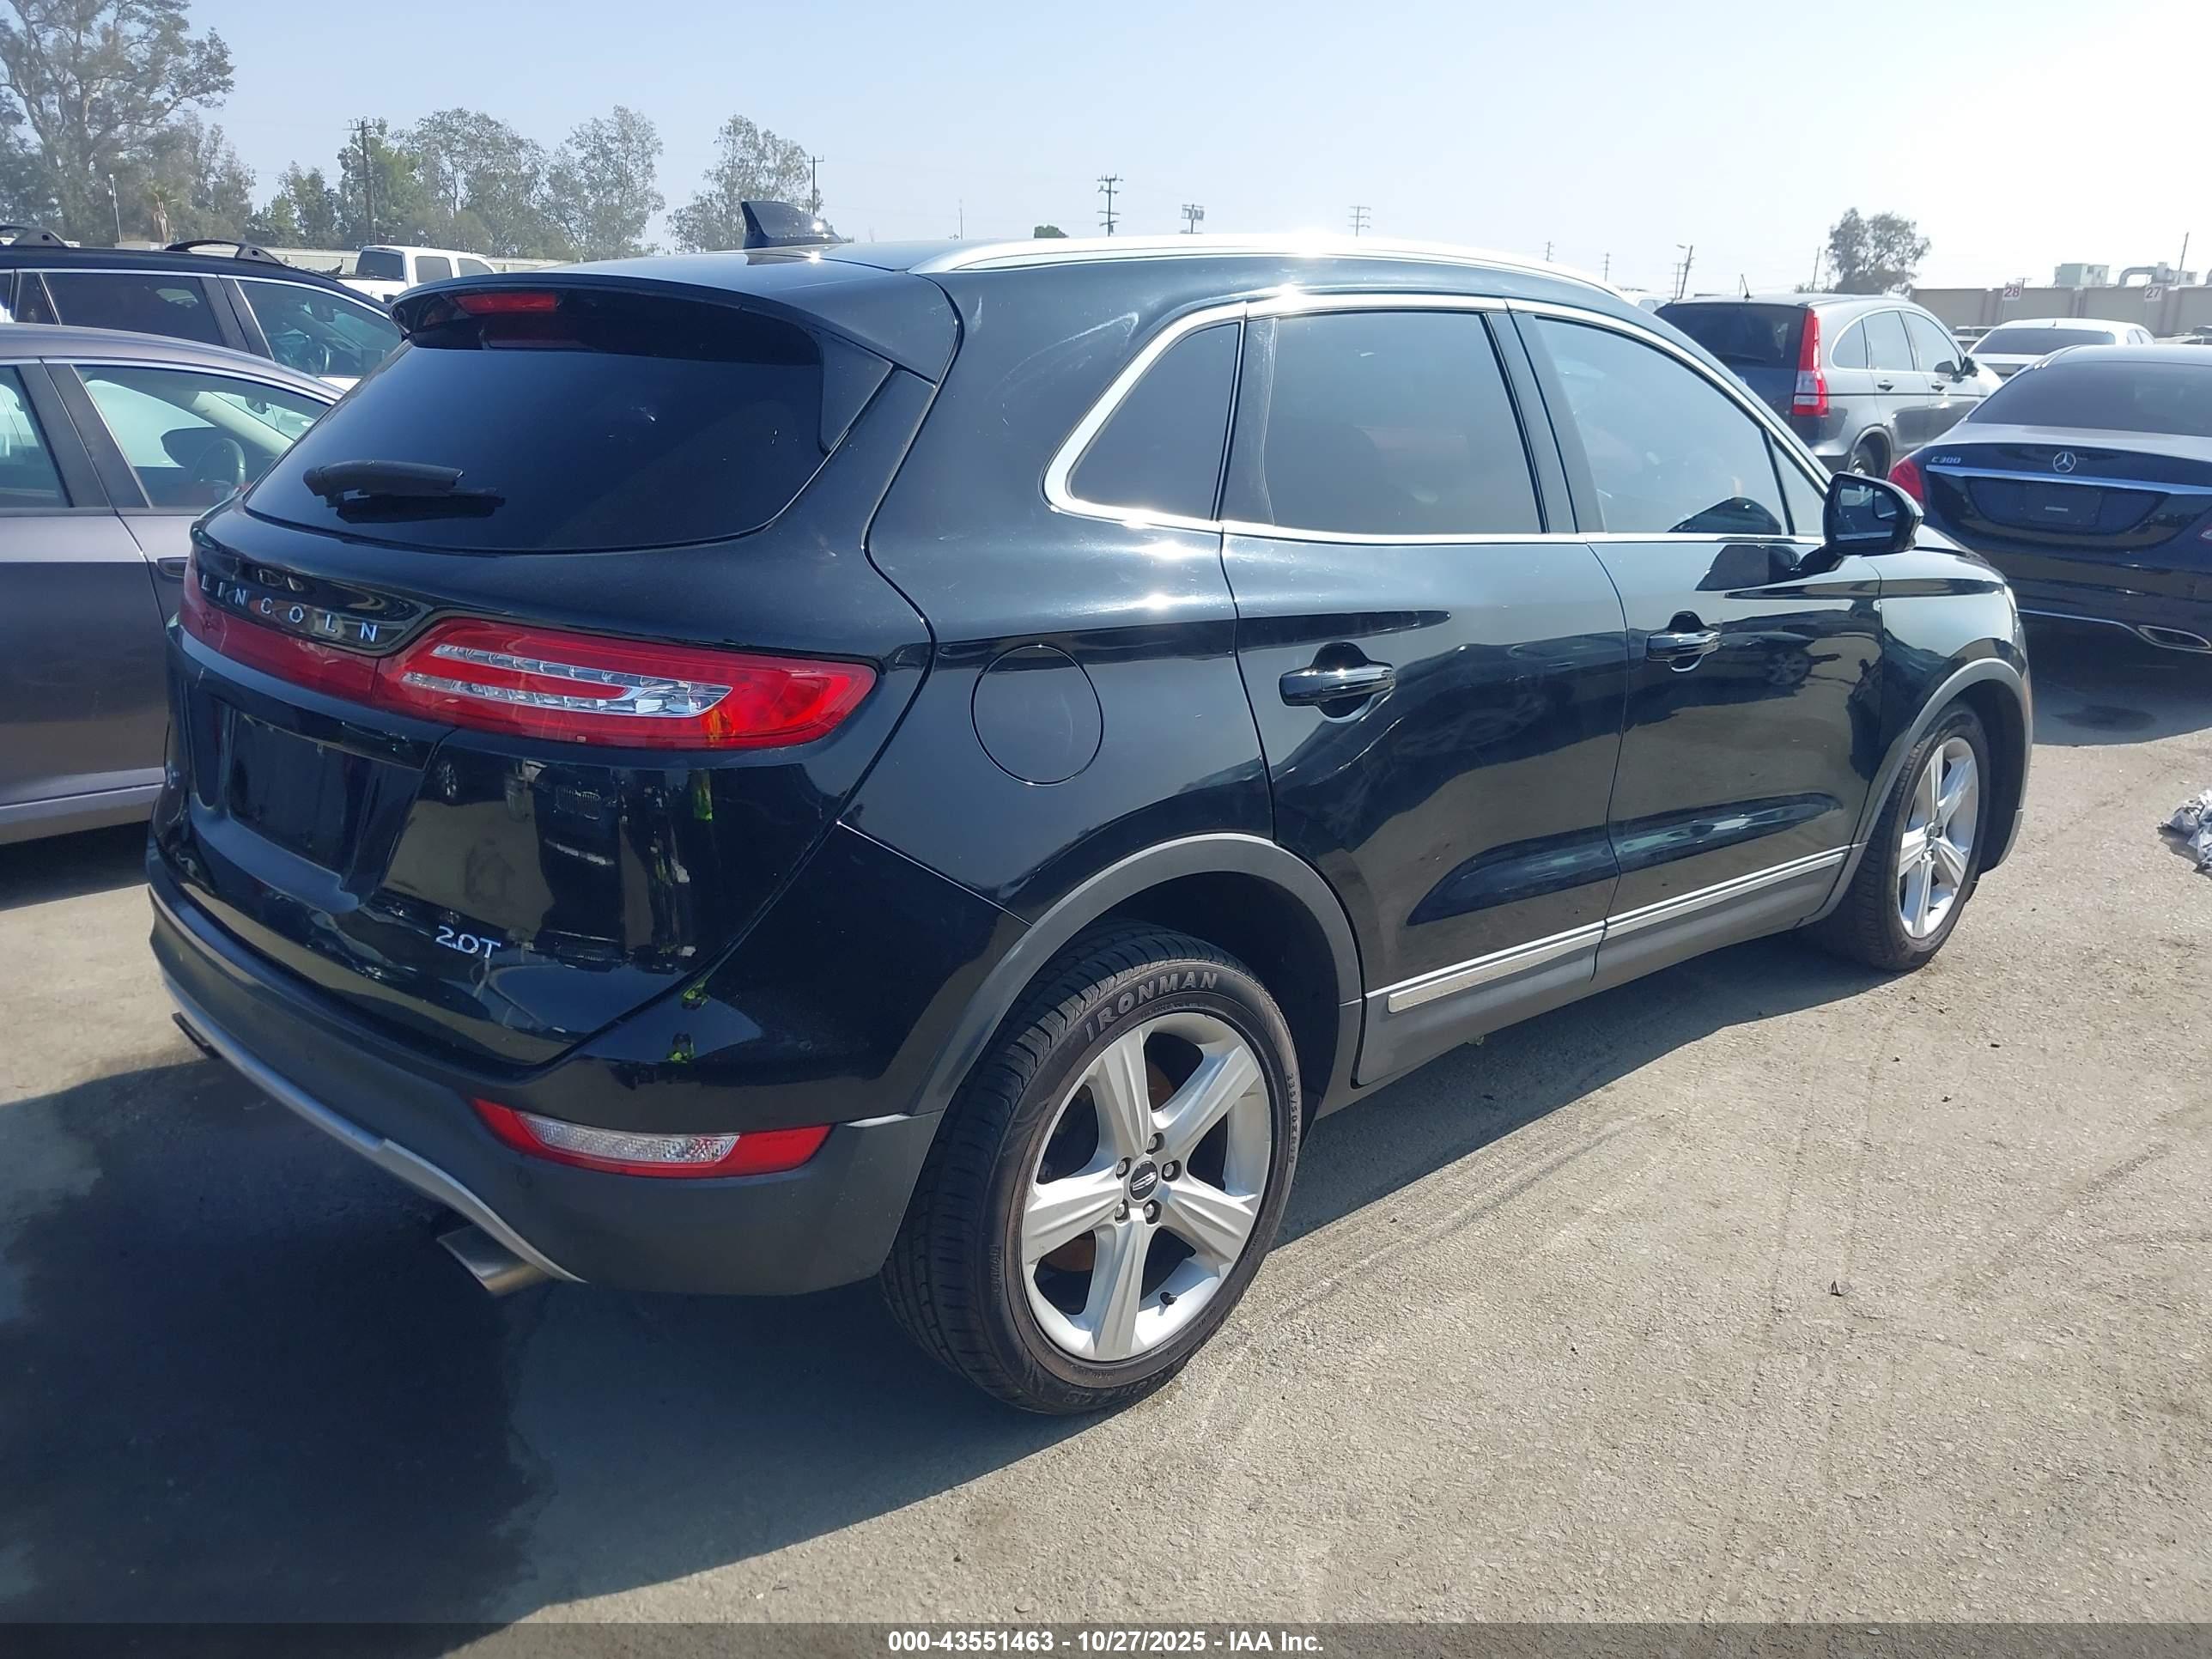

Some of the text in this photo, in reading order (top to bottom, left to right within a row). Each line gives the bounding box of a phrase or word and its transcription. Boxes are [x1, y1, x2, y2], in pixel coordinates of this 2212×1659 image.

[2003, 287, 2021, 298] 28
[2146, 287, 2161, 299] 27
[200, 574, 378, 642] LINCOLN
[435, 925, 501, 958] 2.0T
[1085, 971, 1218, 1042] IRONMAN
